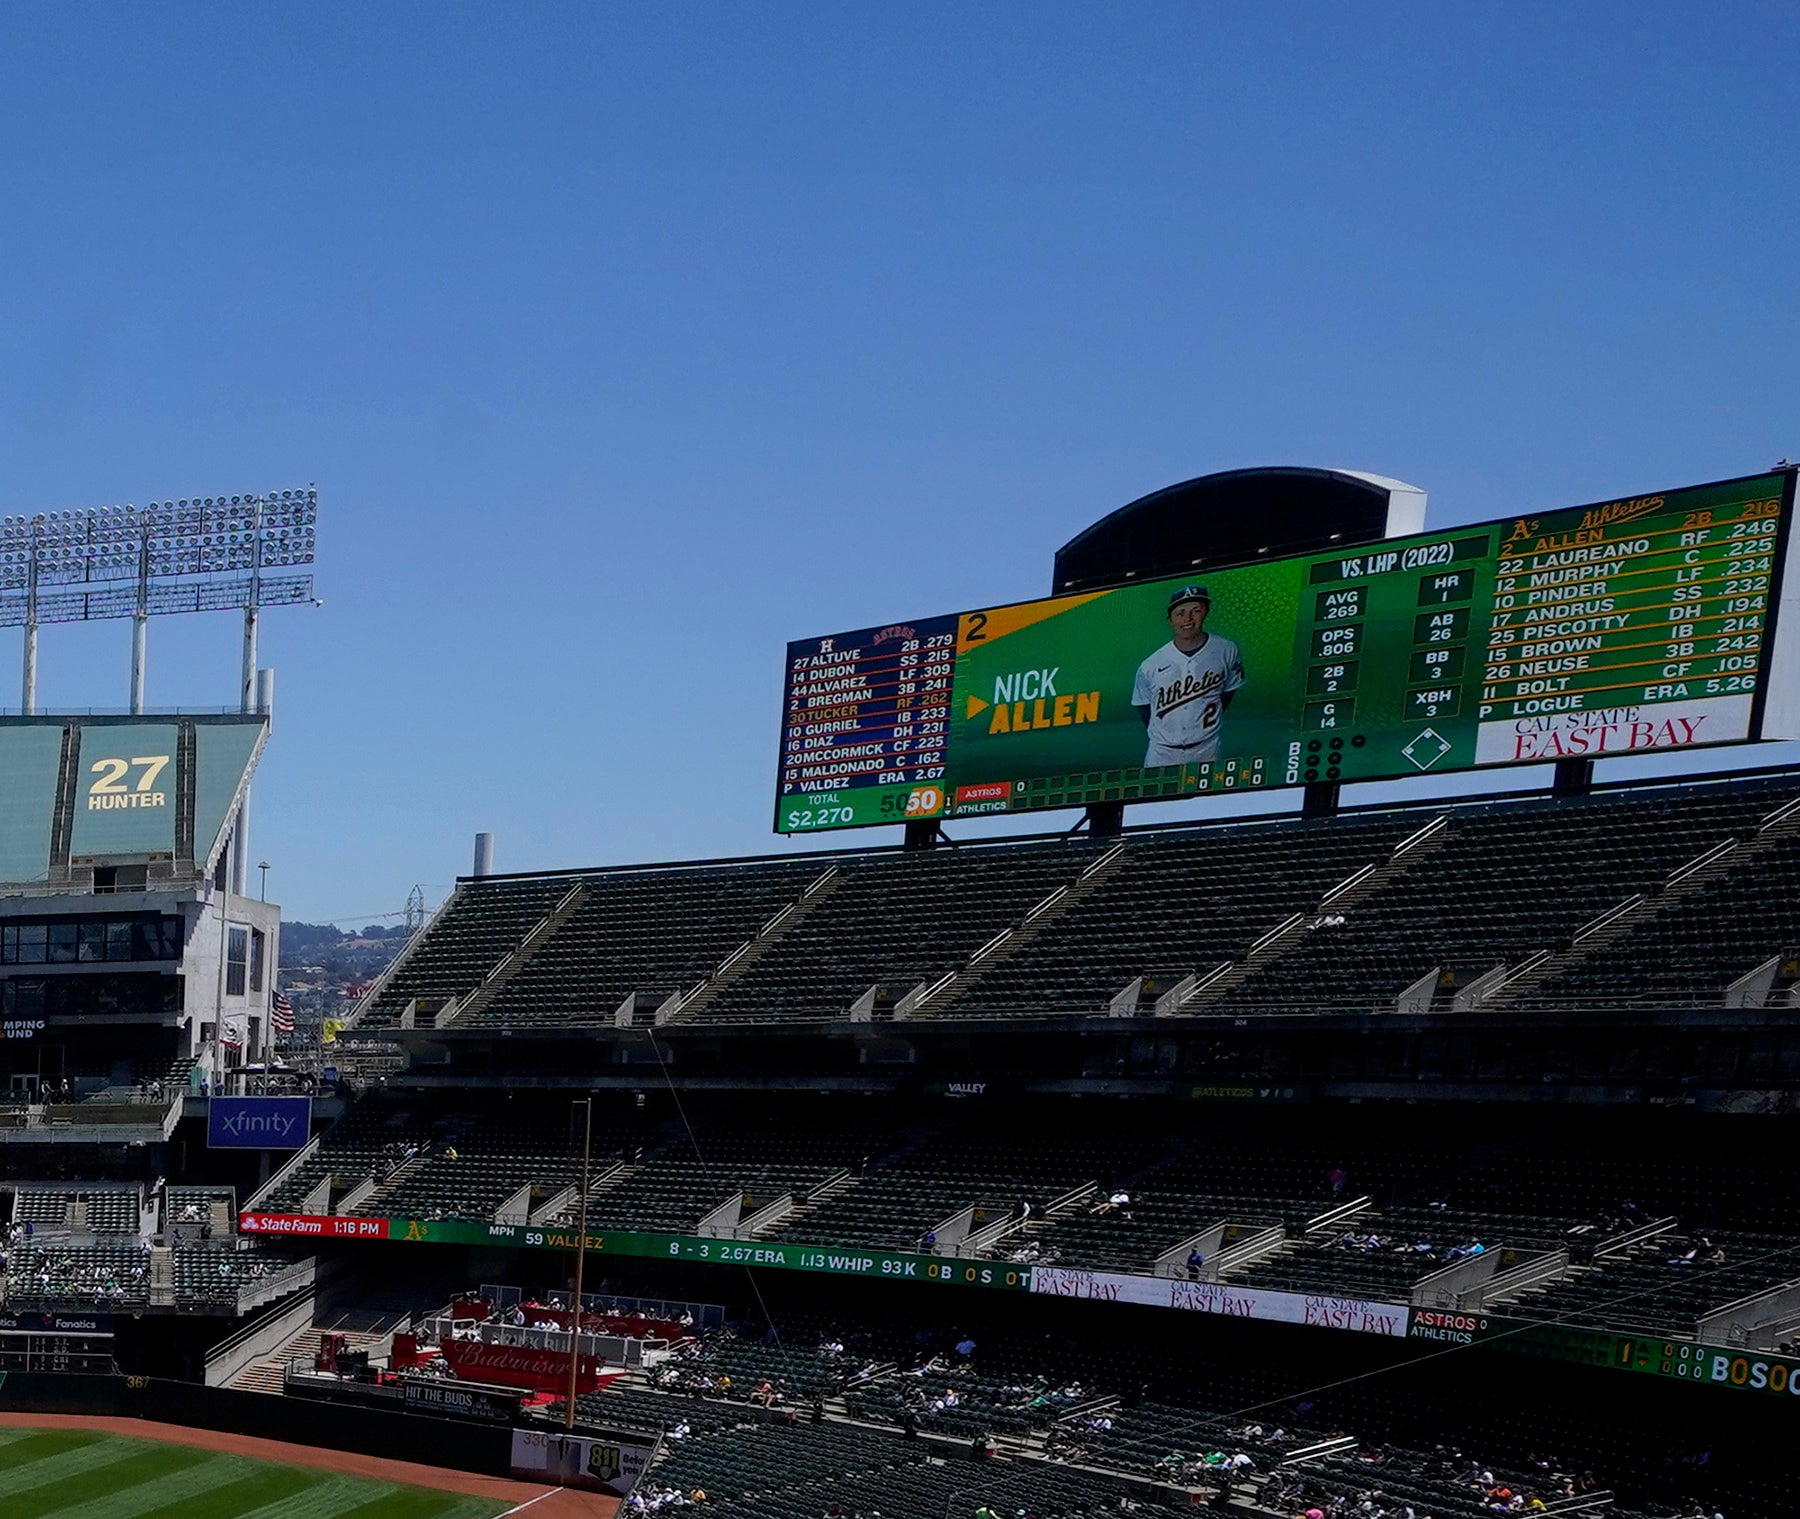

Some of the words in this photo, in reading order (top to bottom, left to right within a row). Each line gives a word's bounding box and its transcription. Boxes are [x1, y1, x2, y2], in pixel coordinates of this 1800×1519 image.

[1535, 528, 1605, 551] ALLEN
[1367, 552, 1397, 574] LHP
[1401, 541, 1455, 572] (2022)
[1532, 539, 1650, 570] LAUREANO
[1530, 560, 1625, 588] MURPHY
[1528, 581, 1608, 606] PINDER
[1524, 598, 1616, 624] ANDRUS
[966, 613, 989, 641] 2
[1523, 613, 1631, 641] PISCOTTY
[811, 649, 861, 667] ALTUVE
[1521, 635, 1602, 659] BROWN
[810, 664, 856, 681] DUBON
[1518, 656, 1590, 677] NEUSE
[808, 676, 867, 695] ALVAREZ
[993, 666, 1060, 704] NICK
[1516, 677, 1571, 696] BOLT
[807, 689, 873, 708] BREGMAN
[1513, 694, 1584, 716] LOGUE
[807, 705, 859, 721] TUCKER
[988, 691, 1101, 735] ALLEN
[1515, 716, 1559, 734] CAL
[1566, 706, 1641, 730] STATE
[805, 719, 861, 736] GURRIEL
[1514, 725, 1618, 760] EAST
[1628, 715, 1708, 750] BAY
[802, 743, 884, 764] MCCORMICK
[804, 736, 834, 749] DIAZ
[90, 755, 170, 792] 27
[801, 758, 885, 779] MALDONADO
[799, 777, 850, 793] VALDEZ
[88, 791, 166, 811] HUNTER
[787, 806, 854, 829] $2,270
[222, 1112, 296, 1137] xfinity
[334, 1221, 356, 1234] 1:16
[360, 1221, 379, 1235] PM
[55, 1318, 97, 1330] Fanatics
[1414, 1311, 1477, 1331] ASTROS
[1410, 1325, 1474, 1344] ATHLETICS
[126, 1375, 149, 1388] 367
[405, 1385, 422, 1399] HIT
[424, 1387, 443, 1402] THE
[444, 1391, 473, 1408] BUDS
[590, 1443, 619, 1469] 811
